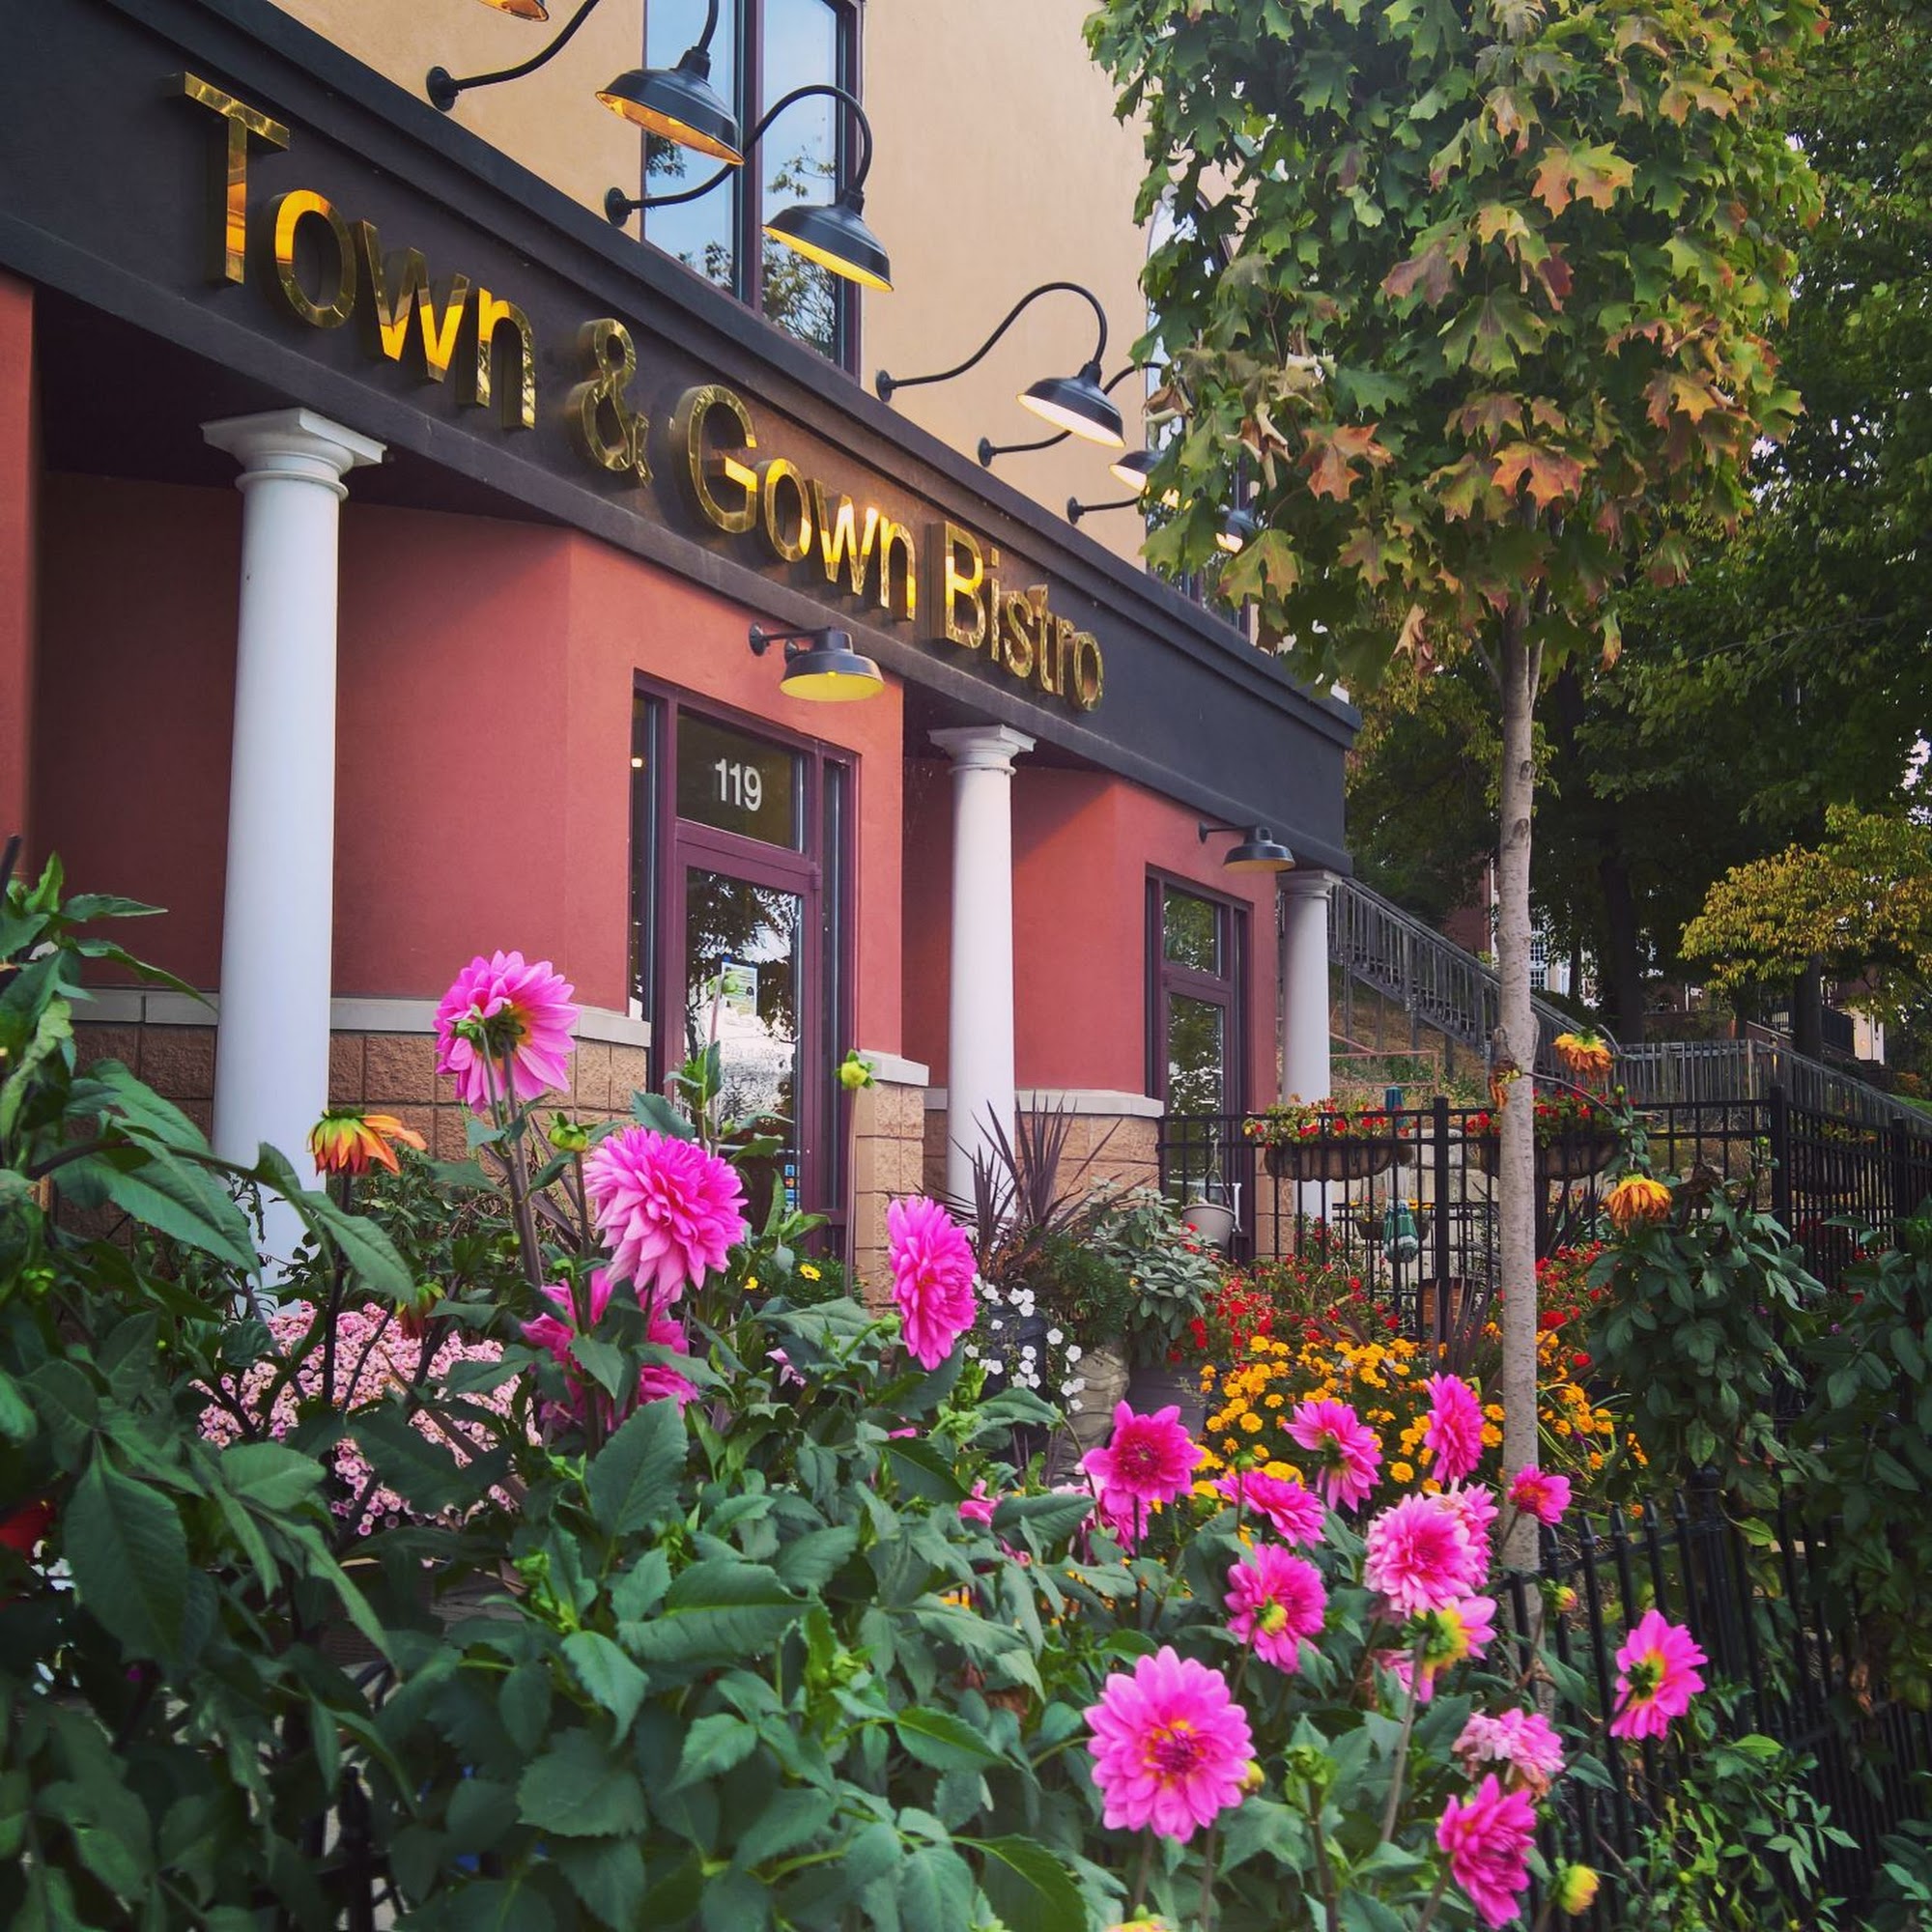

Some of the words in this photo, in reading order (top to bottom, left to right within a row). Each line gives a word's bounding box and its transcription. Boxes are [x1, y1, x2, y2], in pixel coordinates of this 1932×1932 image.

[183, 71, 537, 431] Town
[580, 317, 654, 485] &
[686, 384, 917, 622] Gown
[944, 519, 1104, 713] Bistro
[715, 758, 762, 811] 119
